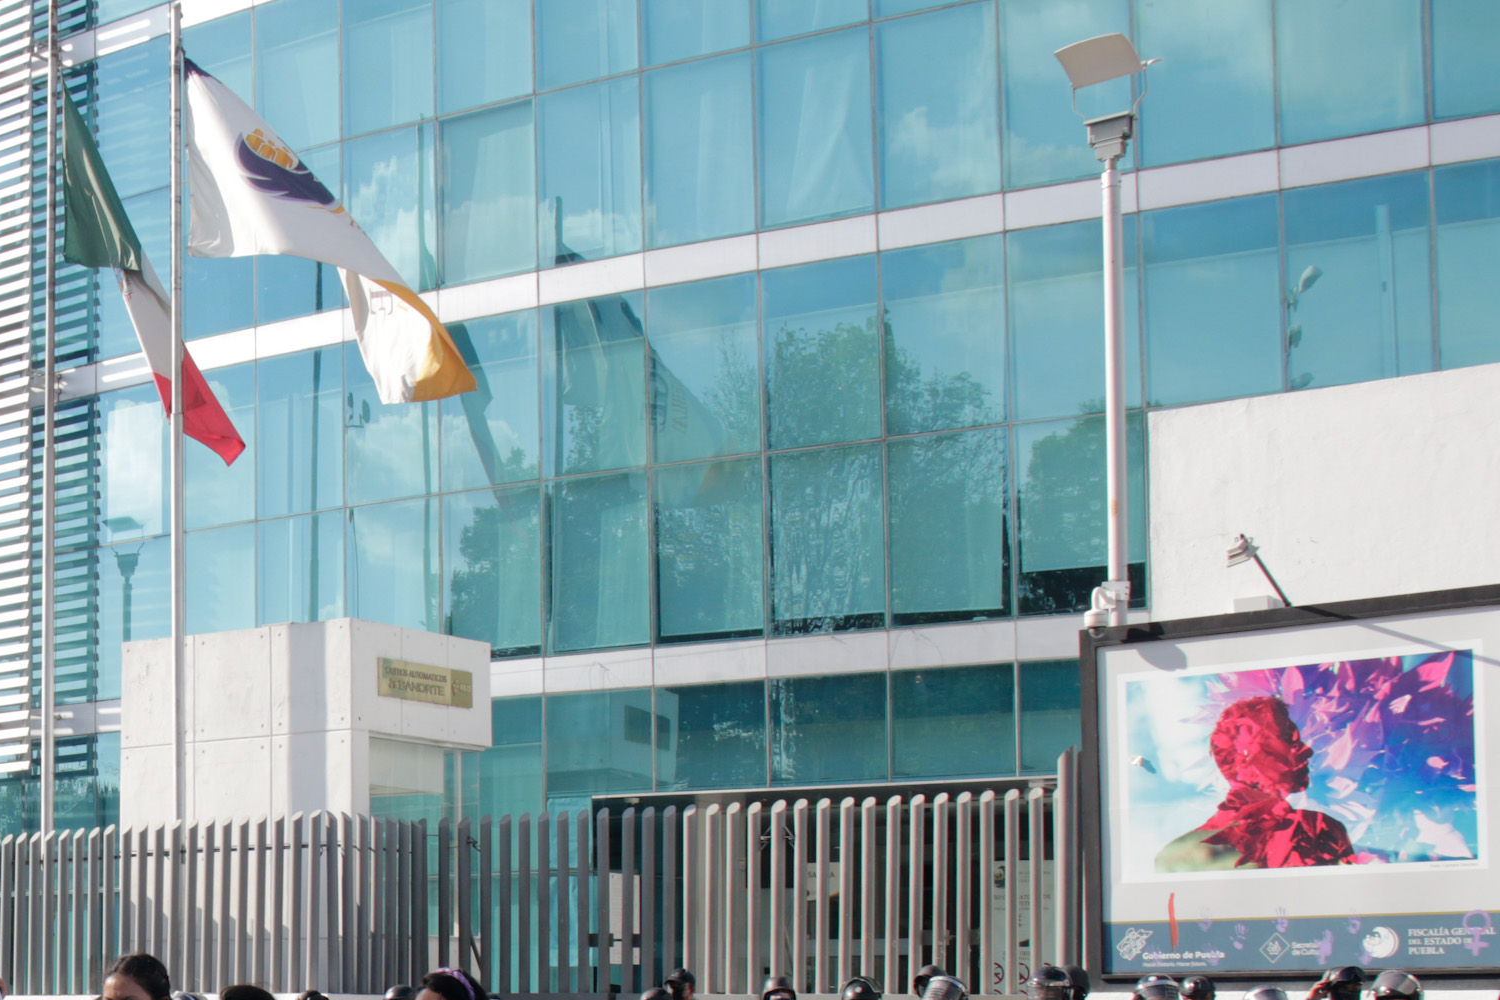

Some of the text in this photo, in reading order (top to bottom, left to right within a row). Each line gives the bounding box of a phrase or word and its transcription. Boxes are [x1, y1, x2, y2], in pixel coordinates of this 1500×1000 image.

[397, 679, 445, 697] BANORTE
[1407, 926, 1450, 937] FISCALÍA
[1423, 936, 1462, 946] ESTADO
[1463, 936, 1474, 944] DE
[1142, 950, 1227, 960] Gobierno de Puebla
[1407, 946, 1446, 955] PUEBLA
